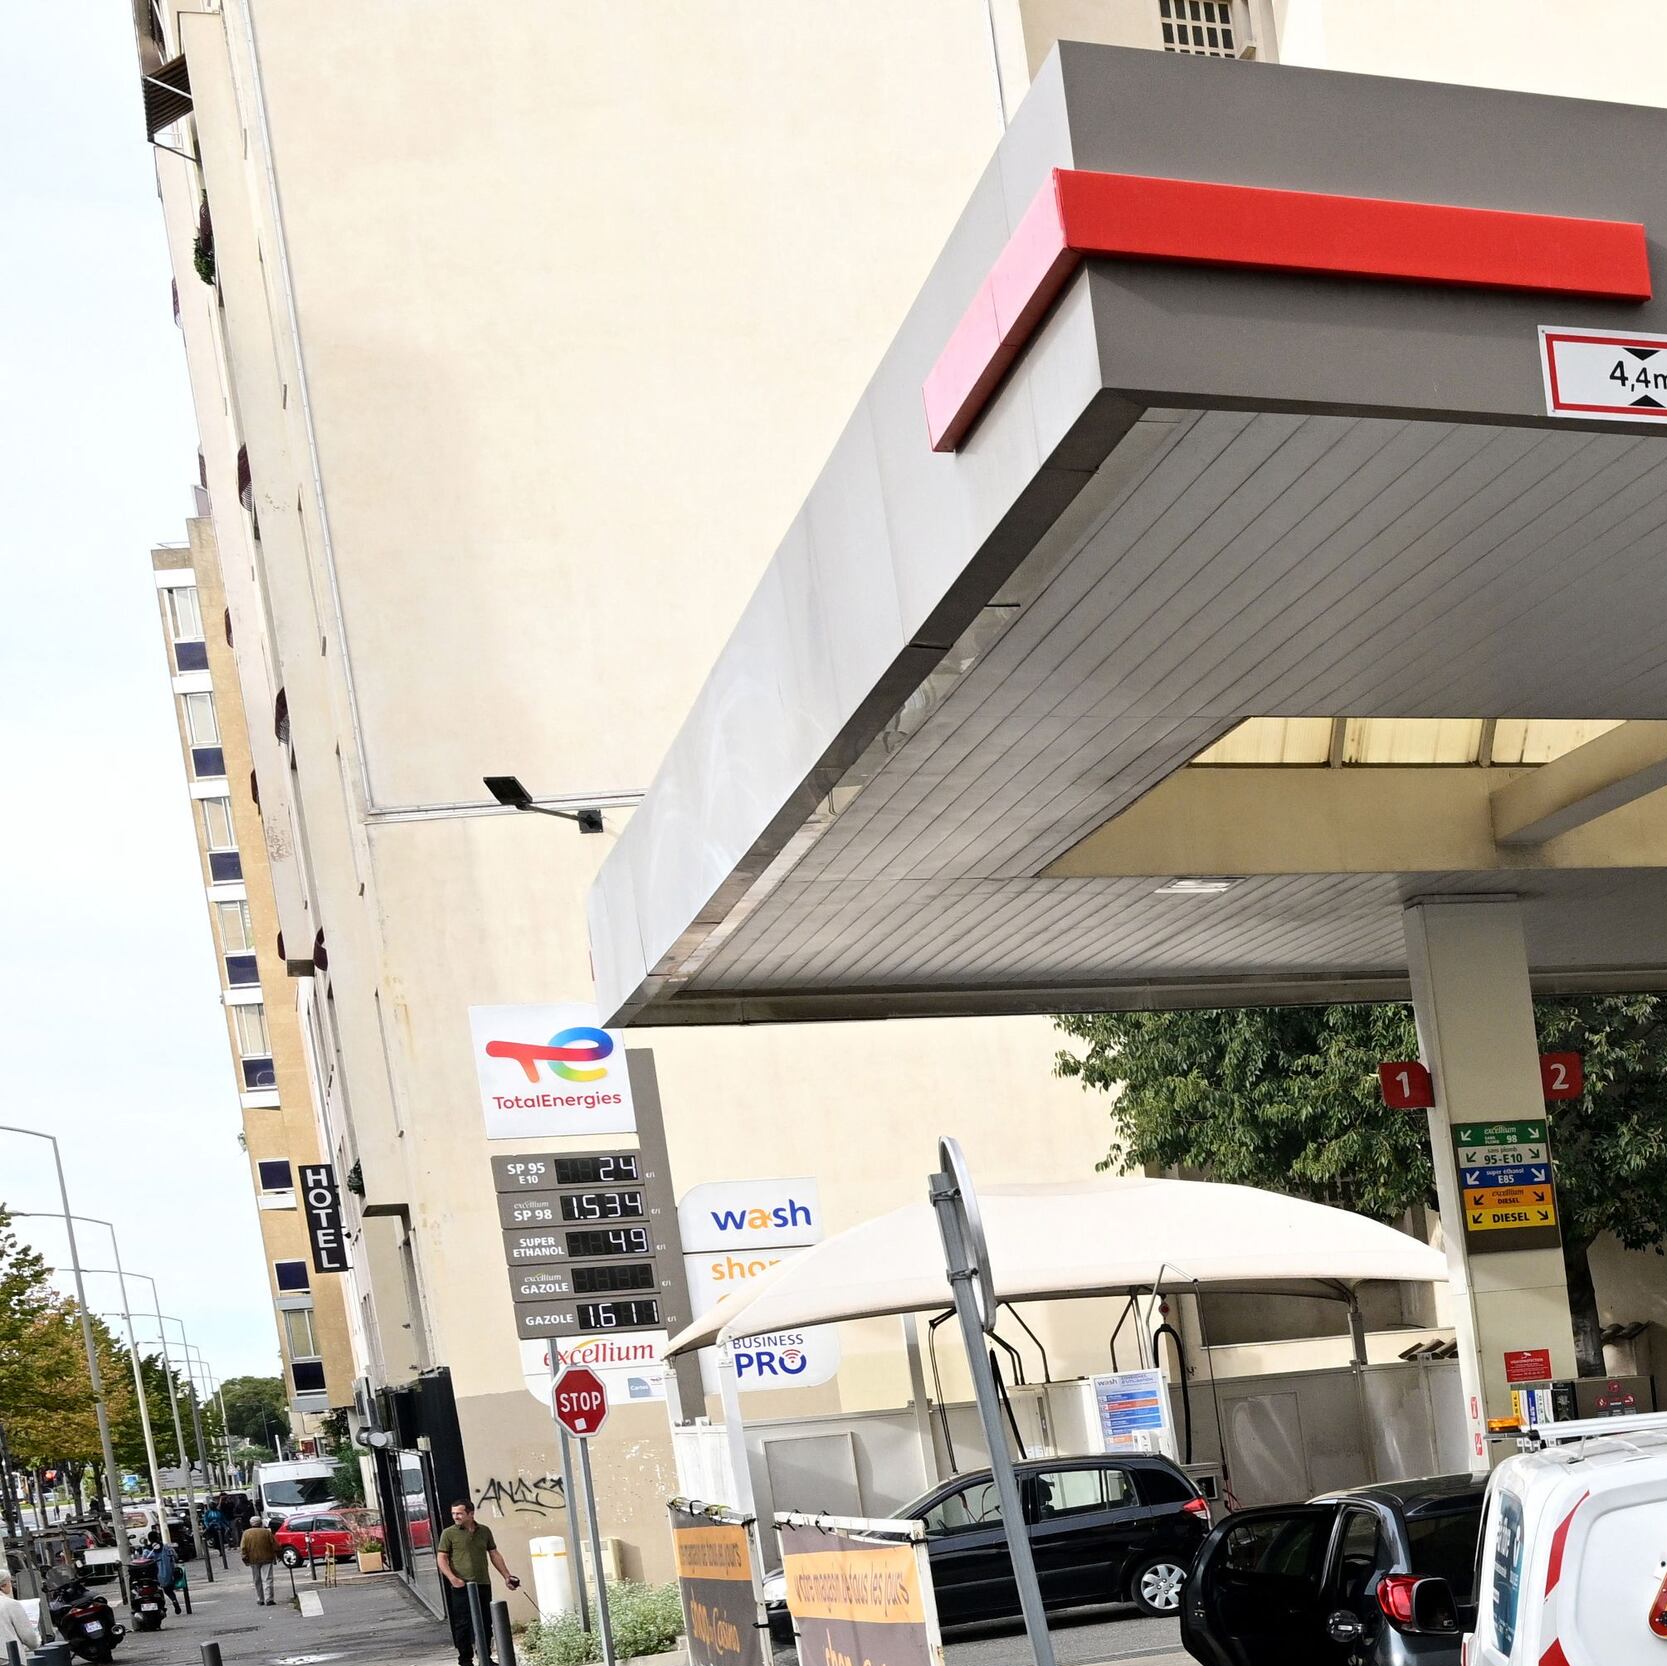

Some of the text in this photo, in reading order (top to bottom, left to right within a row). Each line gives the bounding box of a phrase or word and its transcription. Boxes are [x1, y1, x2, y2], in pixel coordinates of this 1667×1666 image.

[1395, 1071, 1410, 1099] 1
[1549, 1062, 1570, 1091] 2
[492, 1091, 623, 1112] TotalEnergies
[1506, 1135, 1518, 1144] 98
[1484, 1153, 1523, 1165] 95-E10
[507, 1162, 546, 1175] SP 95
[600, 1156, 638, 1181] 24
[518, 1175, 539, 1184] E10
[1498, 1174, 1515, 1184] E85
[514, 1208, 553, 1221] SP 98
[572, 1193, 644, 1219] 1.534
[305, 1167, 340, 1269] HOTEL
[710, 1199, 813, 1232] wash
[1492, 1212, 1530, 1223] DIESEL
[519, 1236, 556, 1247] SUPER
[608, 1227, 649, 1252] 49
[513, 1246, 566, 1258] ETHANOL
[711, 1256, 782, 1281] sho
[521, 1282, 570, 1294] GAZOLE
[525, 1313, 575, 1326] GAZOLE
[732, 1333, 805, 1350] BUSINESS
[733, 1349, 808, 1379] PRO
[559, 1391, 601, 1413] STOP
